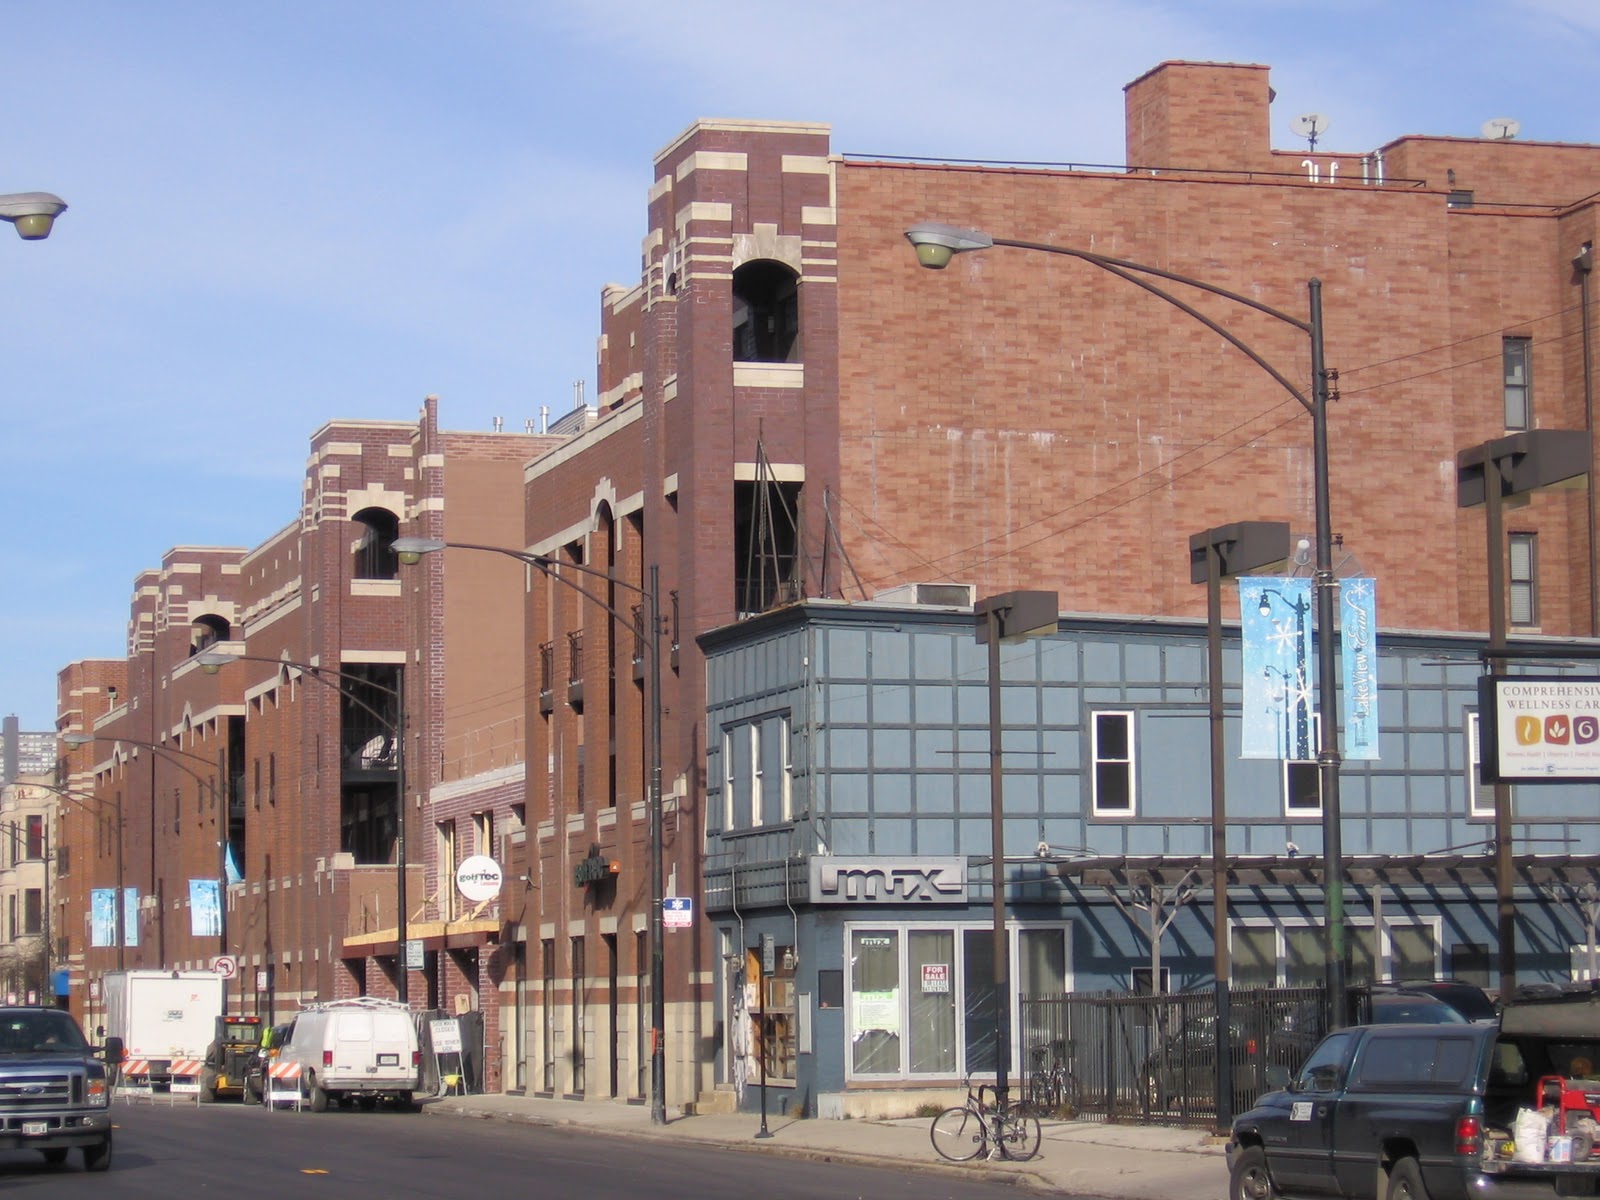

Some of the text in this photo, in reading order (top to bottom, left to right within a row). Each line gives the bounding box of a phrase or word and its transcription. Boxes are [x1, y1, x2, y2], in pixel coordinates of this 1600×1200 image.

[1507, 700, 1570, 709] WELLNESS
[824, 866, 960, 901] mix
[926, 966, 943, 974] FOR
